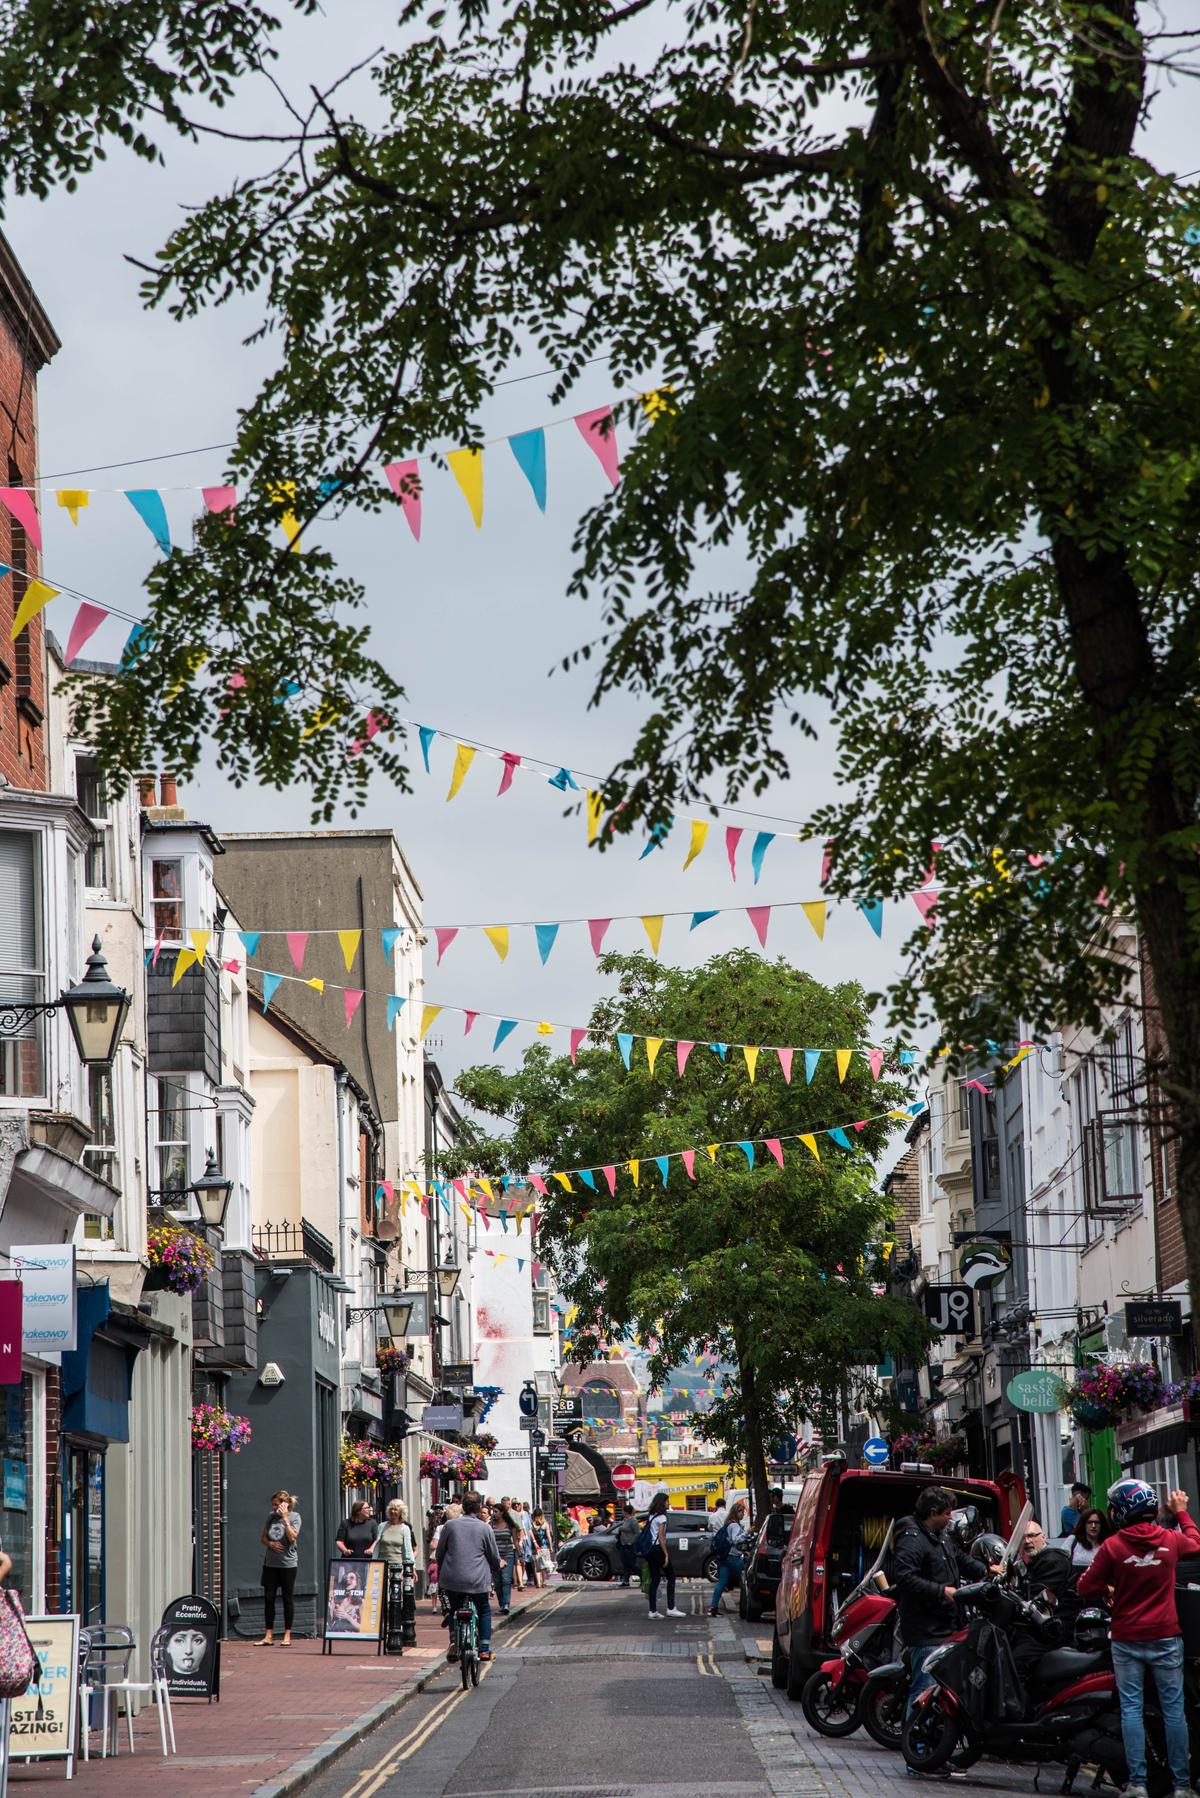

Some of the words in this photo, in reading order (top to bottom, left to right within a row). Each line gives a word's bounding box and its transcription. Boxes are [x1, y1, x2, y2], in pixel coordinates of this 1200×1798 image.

[22, 1293, 68, 1304] hakeaway
[930, 1290, 969, 1331] JOY
[22, 1328, 68, 1341] hakeaway
[1023, 1395, 1052, 1407] belle
[181, 1604, 202, 1613] Pretty
[175, 1611, 207, 1619] Eccentric
